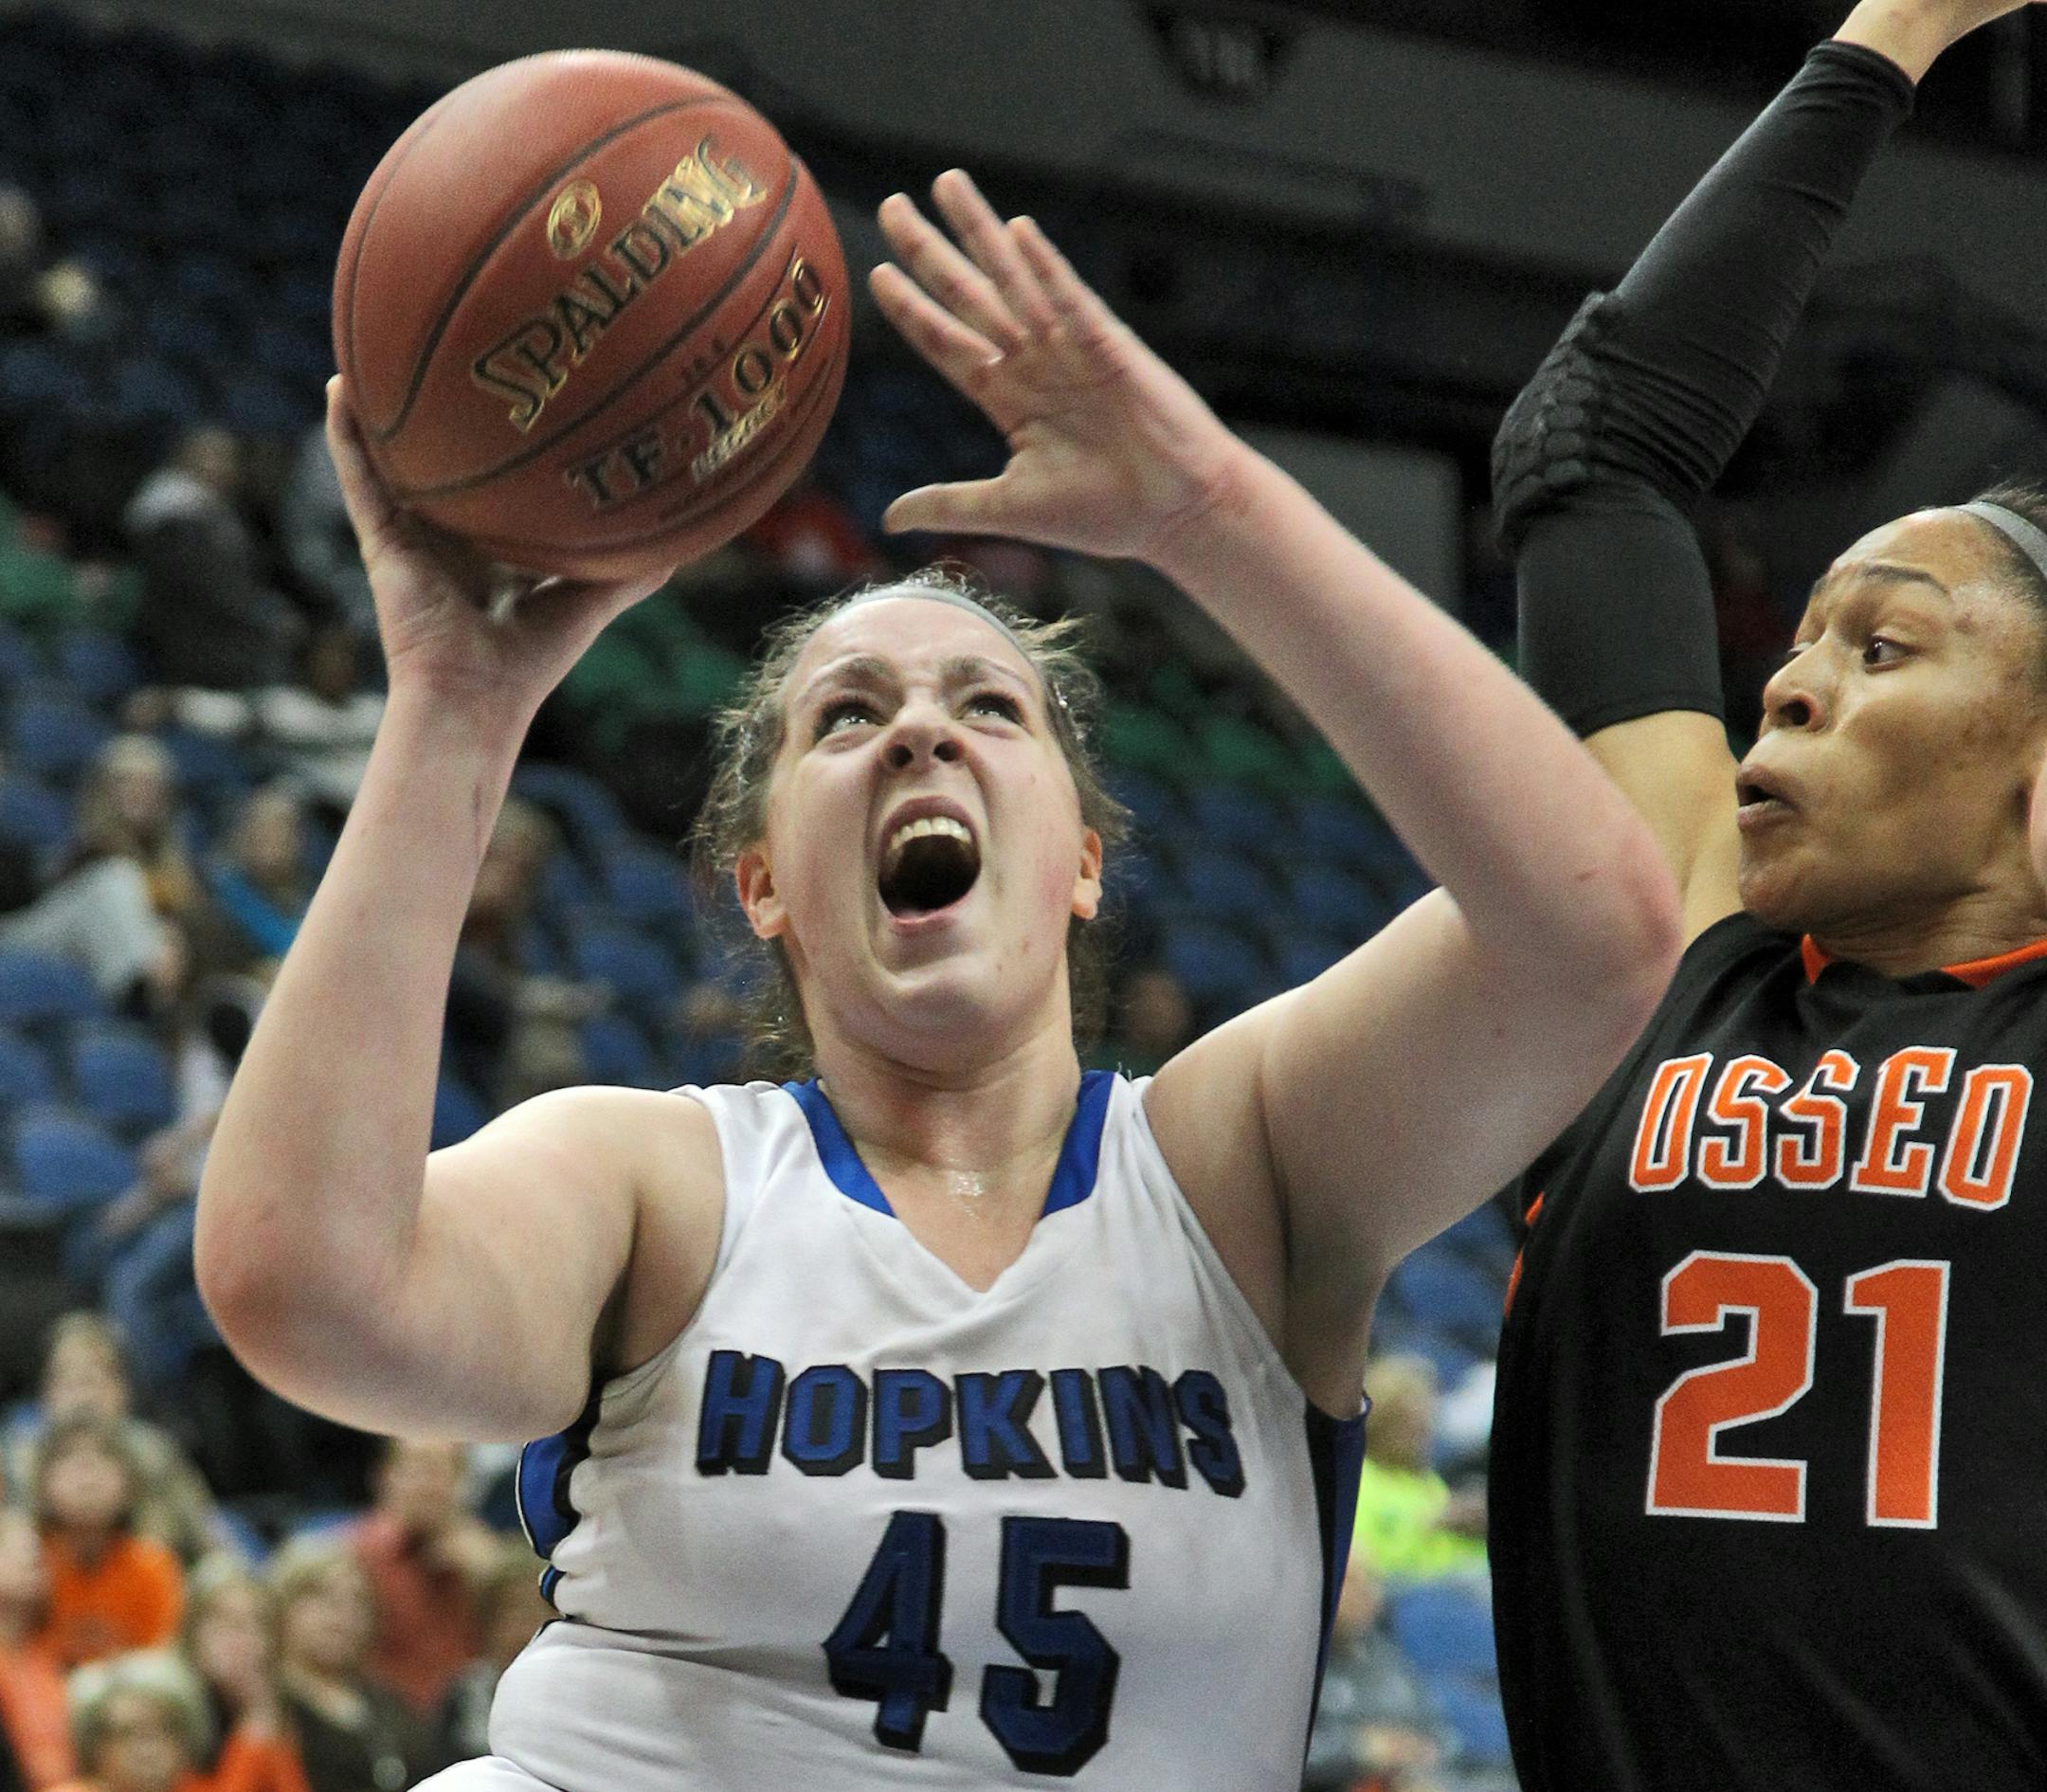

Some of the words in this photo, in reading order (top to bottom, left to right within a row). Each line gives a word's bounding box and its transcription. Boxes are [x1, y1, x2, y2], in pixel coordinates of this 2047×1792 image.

[474, 137, 767, 433] SPALDING
[1630, 1045, 2034, 1211] OSSEO
[695, 1349, 1246, 1498] HOPKINS
[1645, 1249, 1951, 1530] 21
[822, 1509, 1131, 1777] 45
